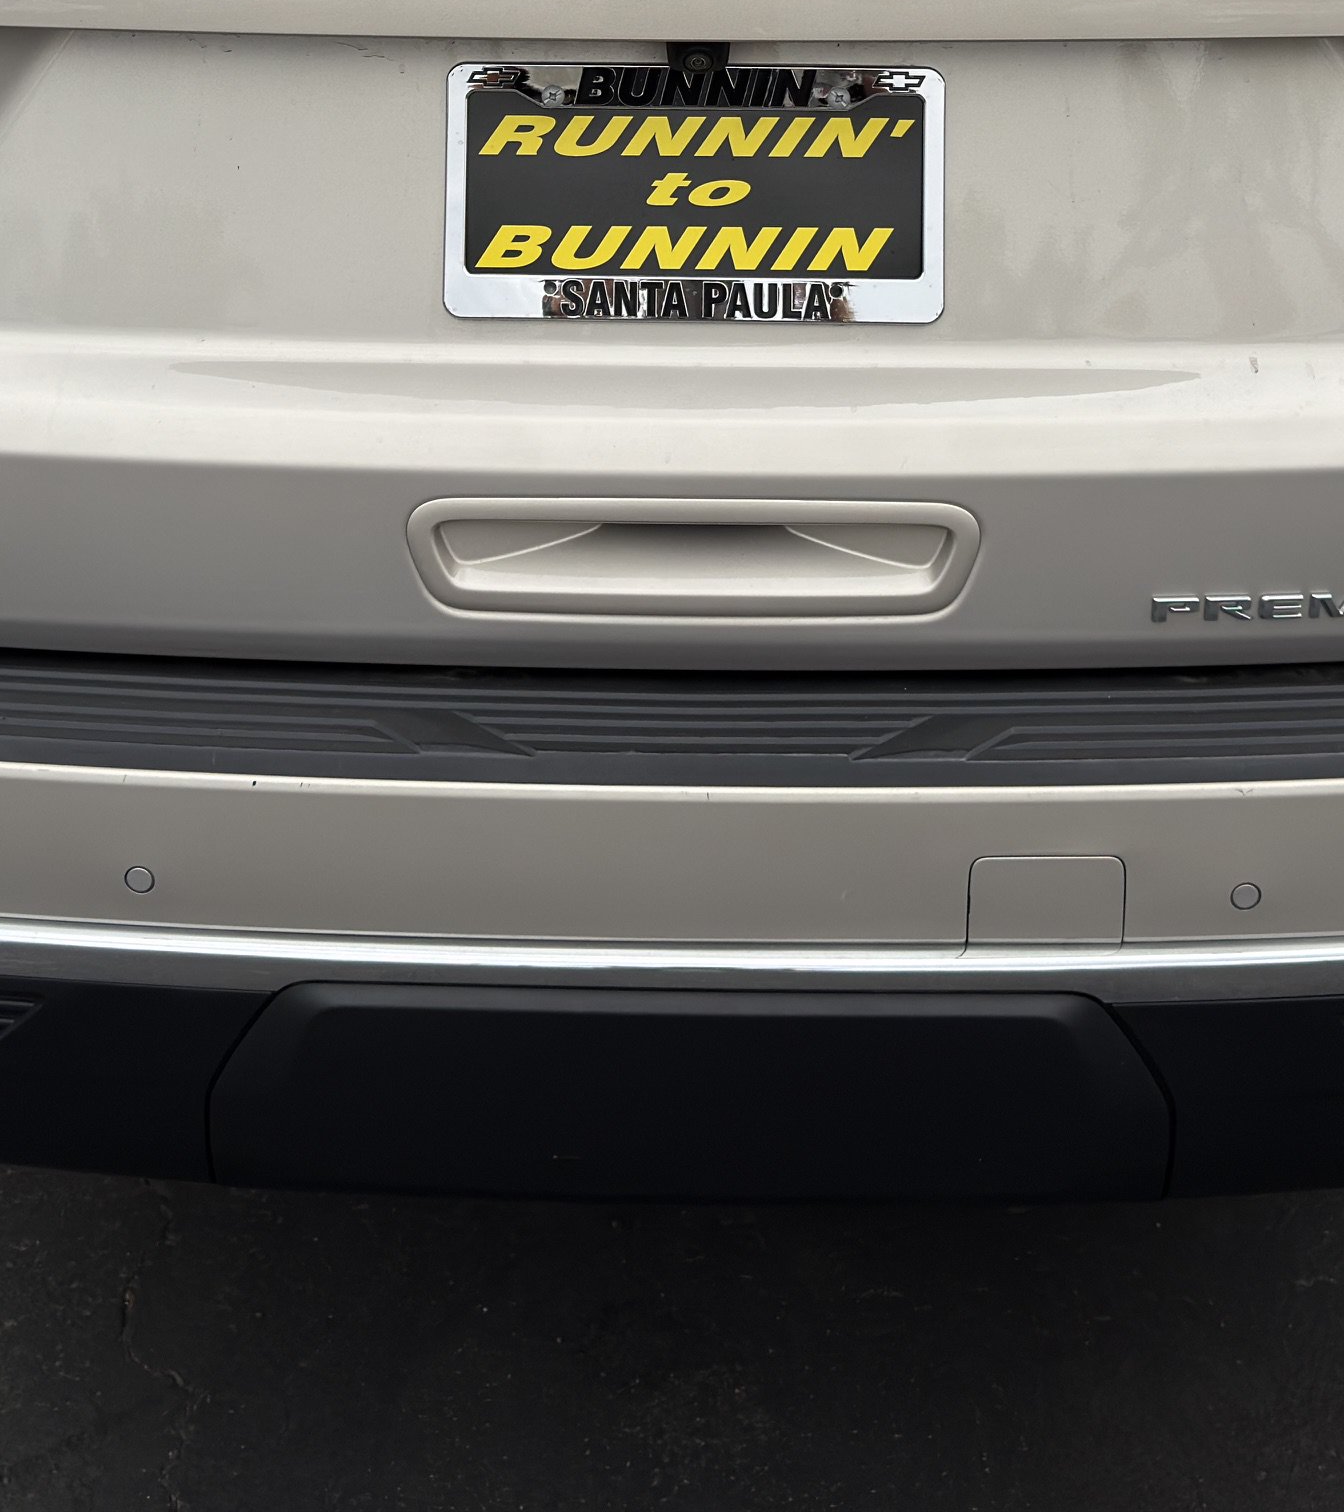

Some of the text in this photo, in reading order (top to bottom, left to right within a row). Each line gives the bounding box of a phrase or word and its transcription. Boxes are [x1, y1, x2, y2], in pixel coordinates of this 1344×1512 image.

[575, 67, 818, 108] BUNNIN
[478, 114, 916, 159] RUNNIN'
[645, 171, 752, 207] to
[474, 224, 895, 272] BUNNIN
[559, 280, 833, 320] SANTA PAULA
